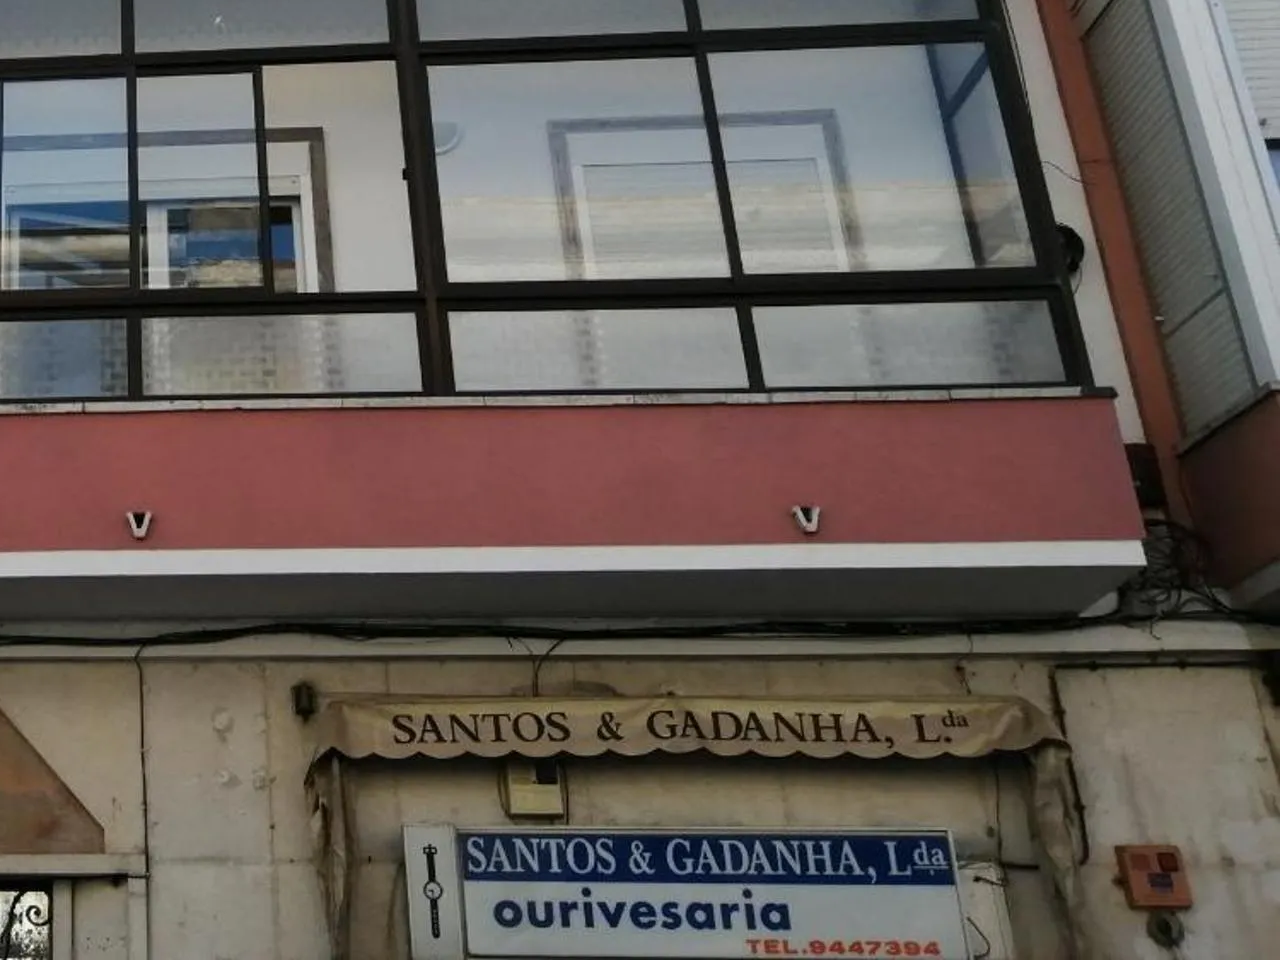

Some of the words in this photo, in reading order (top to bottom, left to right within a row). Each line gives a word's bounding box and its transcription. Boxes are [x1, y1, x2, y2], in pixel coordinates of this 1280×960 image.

[392, 711, 571, 745] SANTOS
[596, 711, 625, 741] &
[466, 837, 617, 875] SANTOS
[629, 840, 656, 875] &
[493, 887, 792, 931] ourivesaria
